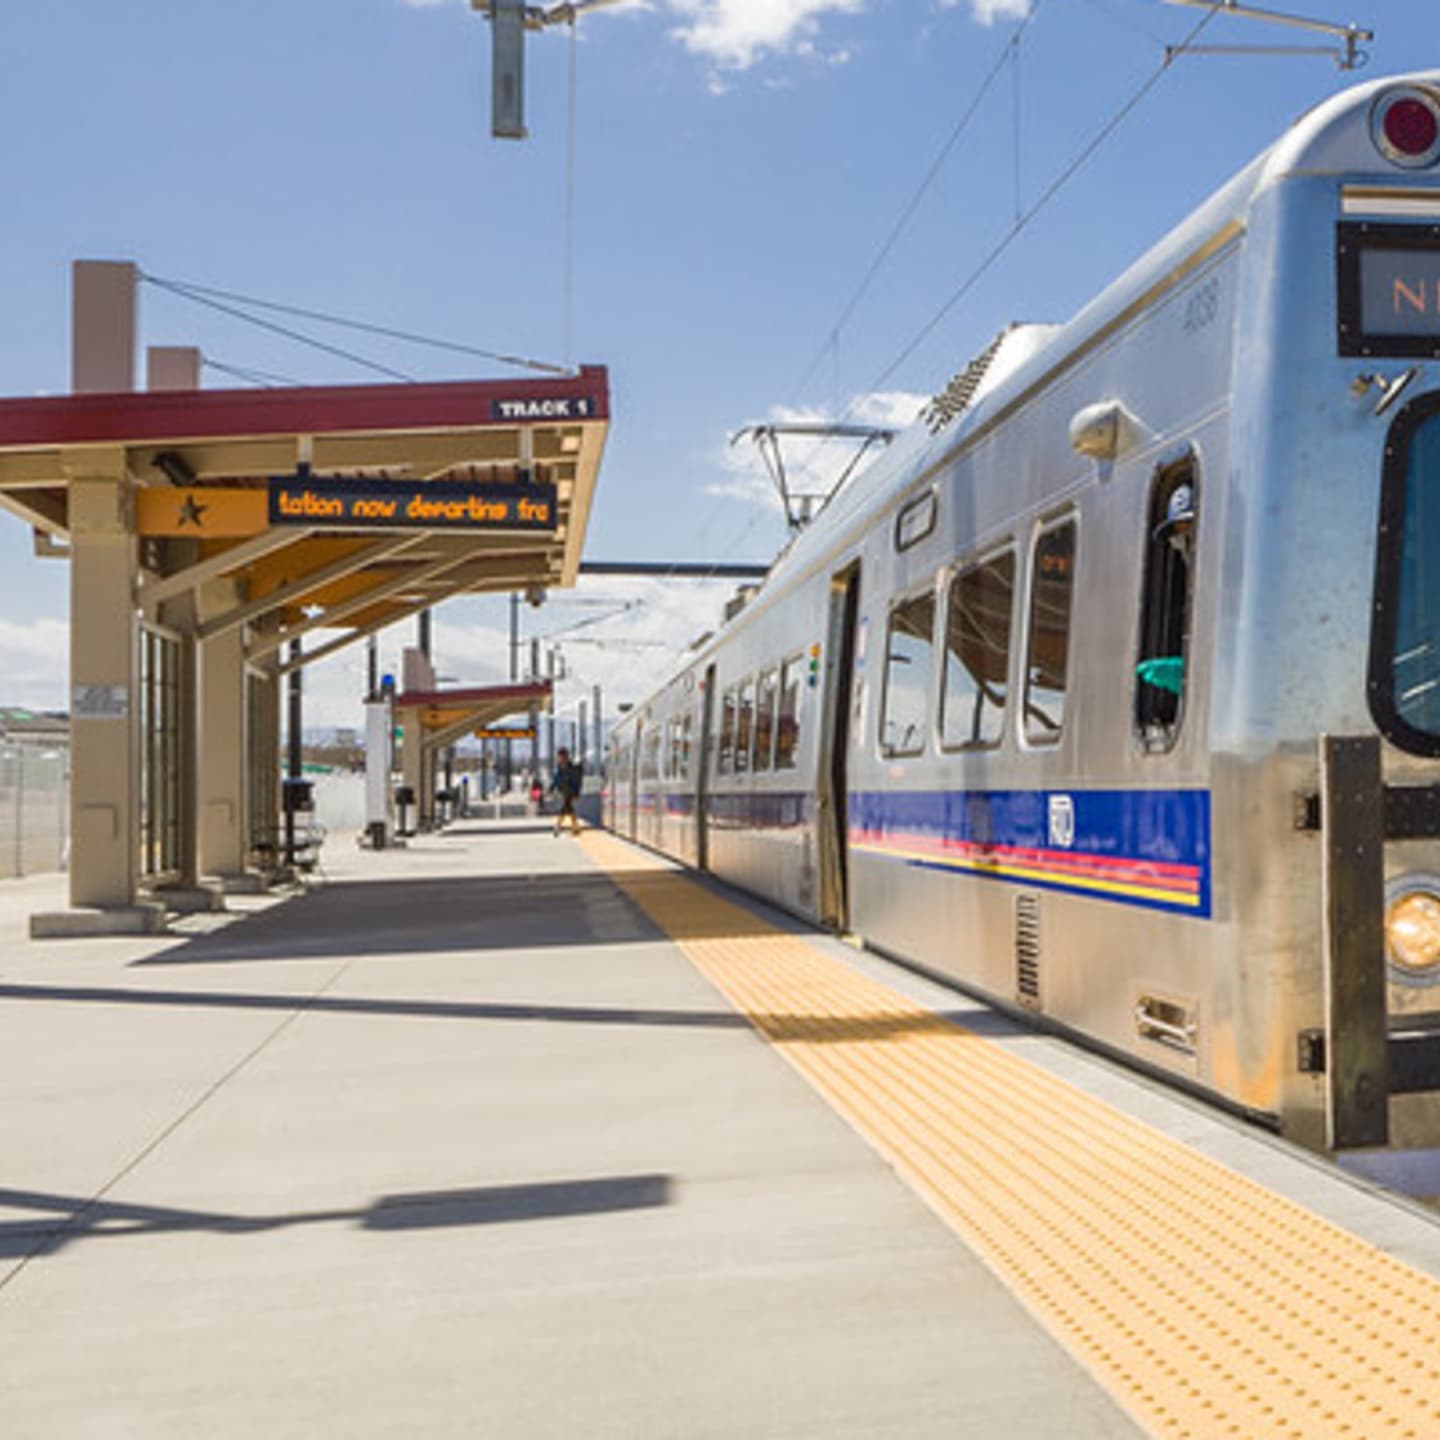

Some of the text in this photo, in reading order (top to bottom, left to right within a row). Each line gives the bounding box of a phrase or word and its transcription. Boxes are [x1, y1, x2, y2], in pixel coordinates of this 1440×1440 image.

[1393, 278, 1426, 314] N
[500, 400, 587, 417] TRACK 1
[279, 490, 343, 517] tation
[352, 499, 397, 517] now
[406, 494, 508, 520] departing
[1048, 794, 1076, 848] RTD
